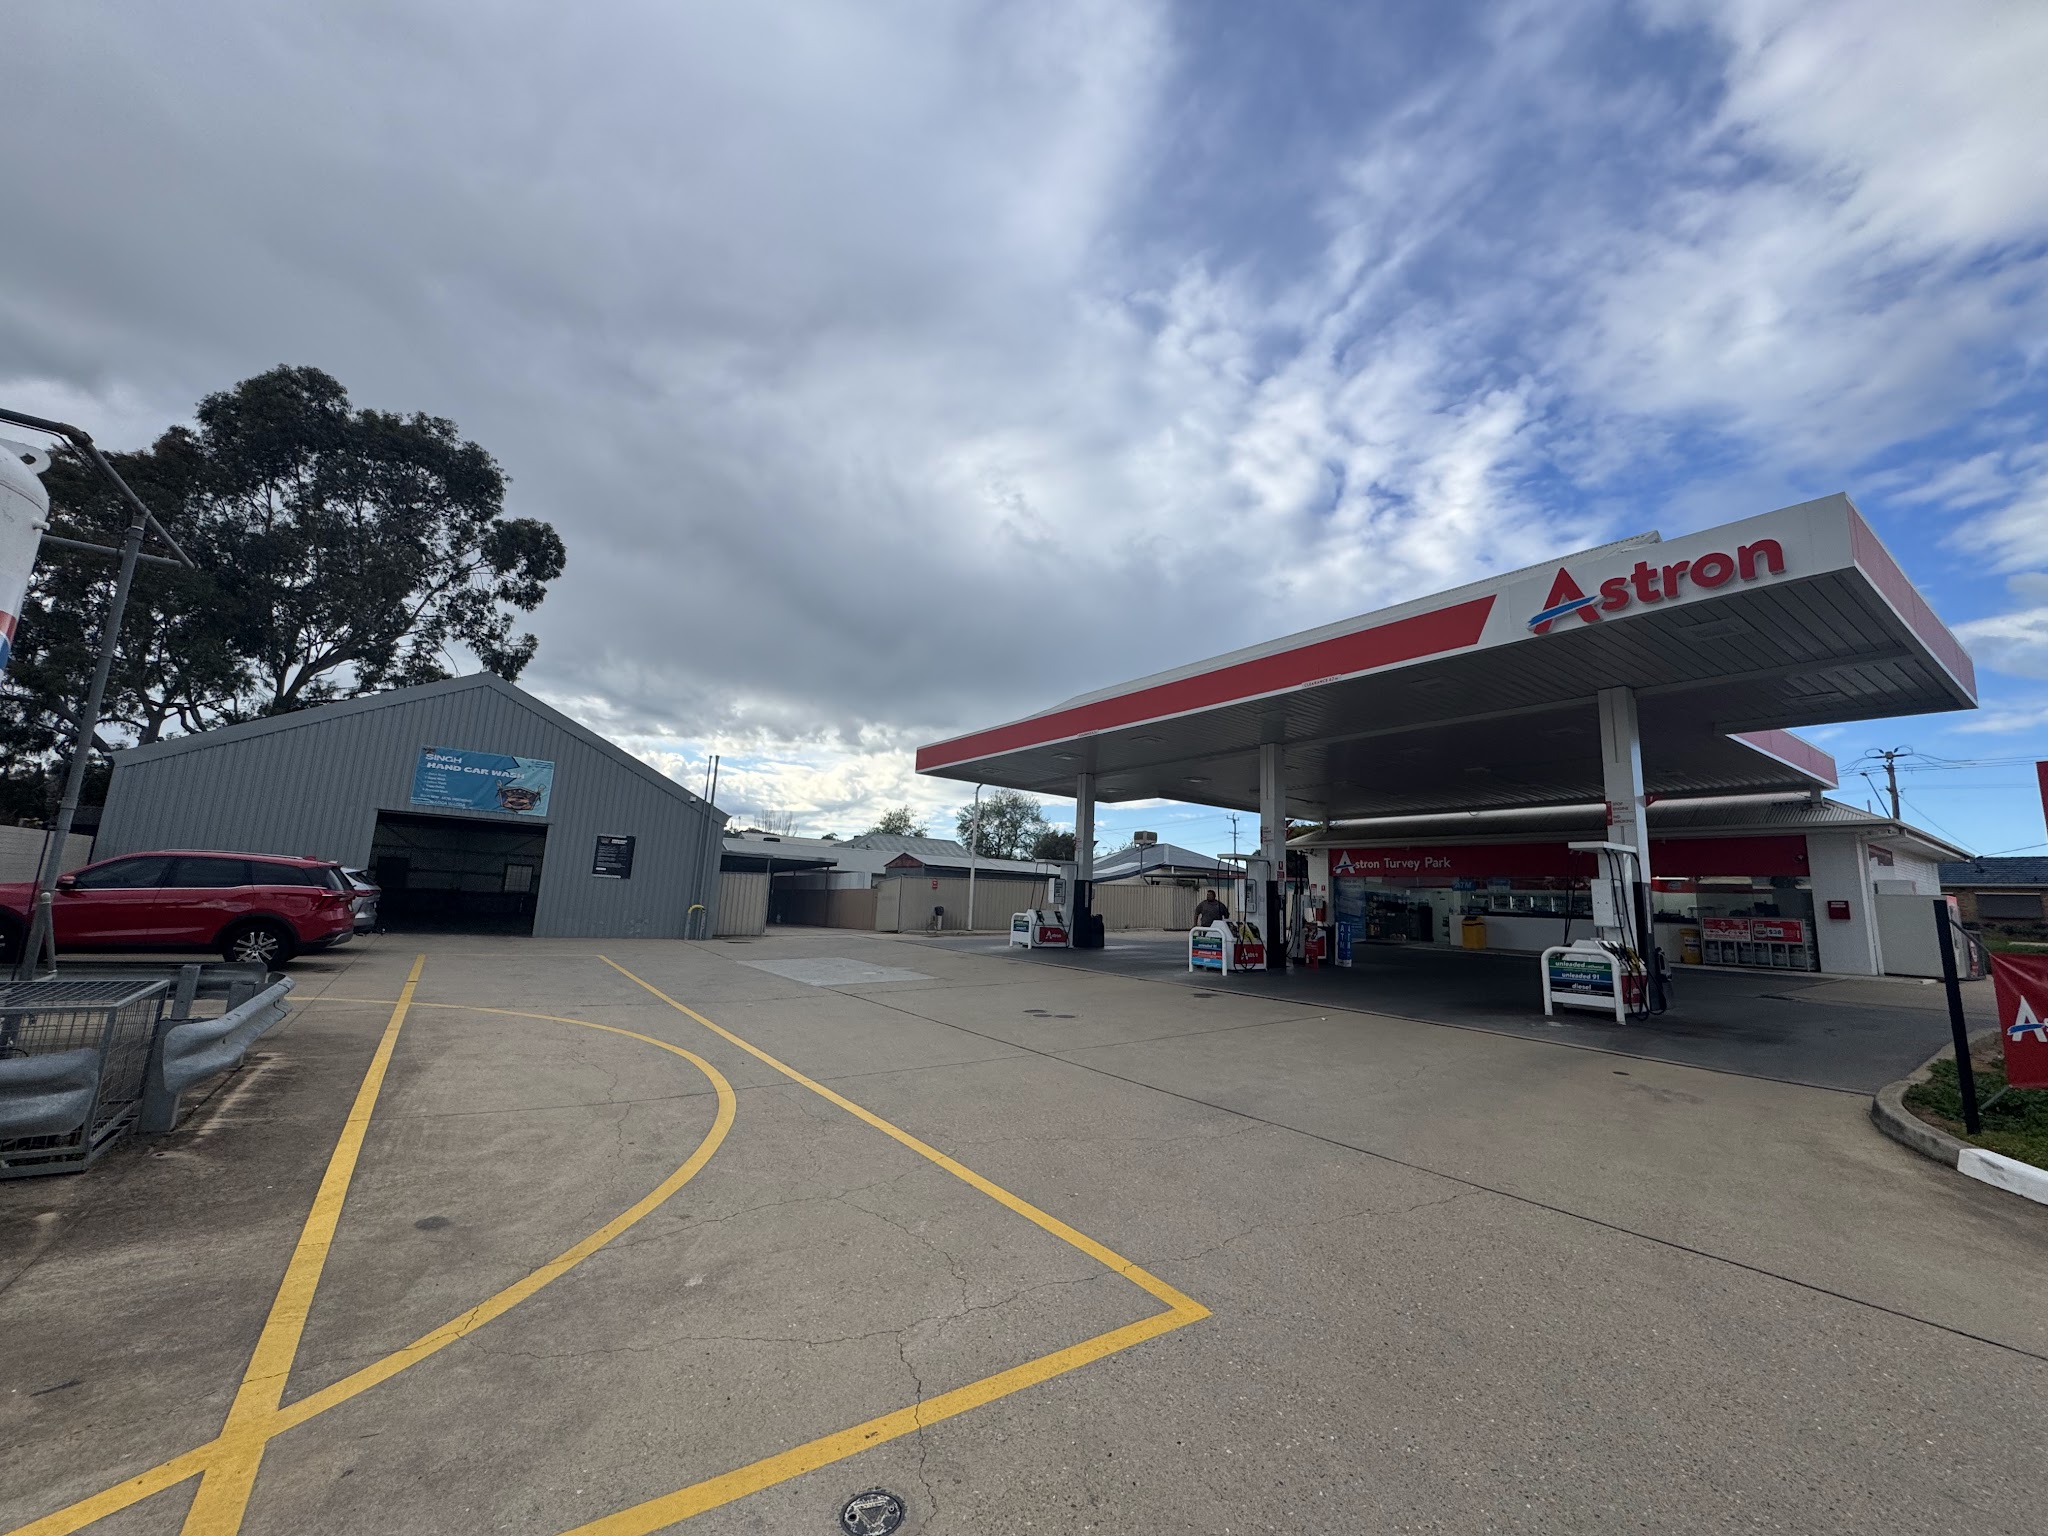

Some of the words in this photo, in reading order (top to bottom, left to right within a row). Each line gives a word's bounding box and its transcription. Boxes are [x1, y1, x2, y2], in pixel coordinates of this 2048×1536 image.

[1528, 539, 1785, 634] Astron
[425, 753, 463, 764] SINGH
[426, 762, 462, 772] HAND
[463, 766, 489, 776] CAR
[491, 770, 525, 780] WASH
[1333, 850, 1380, 874] Astron
[1384, 858, 1420, 873] Turvey
[1425, 856, 1451, 869] Park
[1454, 881, 1473, 889] ATM
[1555, 961, 1586, 969] unleaded
